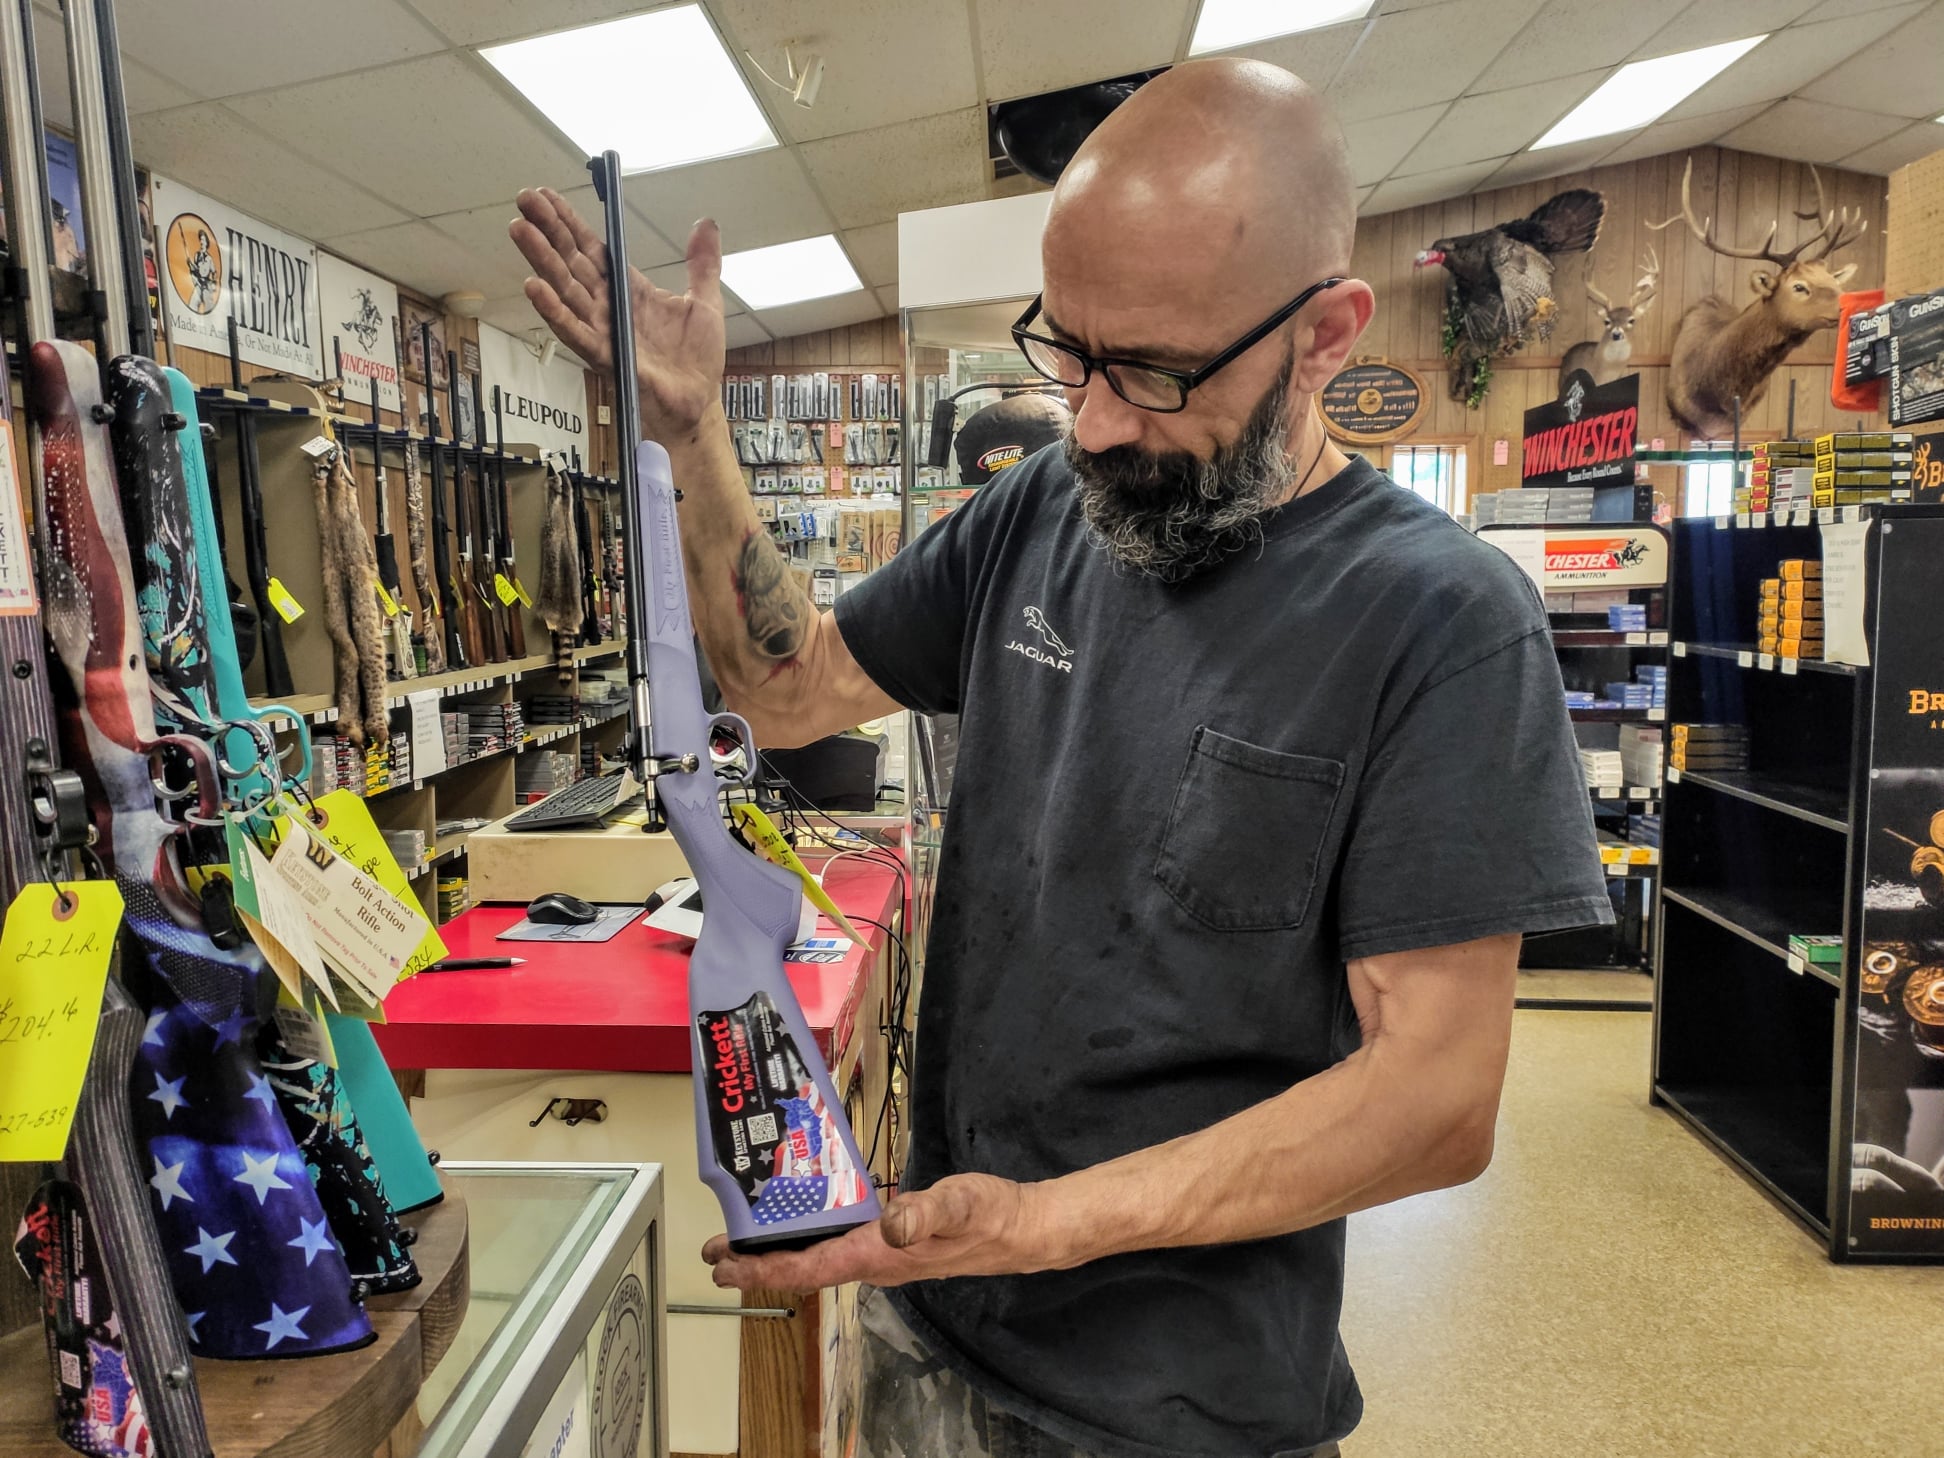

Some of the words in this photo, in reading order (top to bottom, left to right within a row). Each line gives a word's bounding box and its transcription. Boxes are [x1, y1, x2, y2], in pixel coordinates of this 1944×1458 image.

[226, 226, 310, 349] HENRY
[170, 313, 197, 333] Made
[245, 333, 256, 348] Or
[257, 337, 272, 353] Not
[1890, 336, 1899, 363] SKIN
[1891, 365, 1900, 420] SHOTGUN
[504, 391, 582, 434] LEUPOLD
[984, 451, 1004, 465] NITE
[1004, 448, 1024, 459] LITE
[1524, 406, 1637, 479] WINCHESTER
[1593, 465, 1607, 479] Round
[1545, 553, 1610, 569] CHESTER
[1554, 572, 1607, 580] AMMUNITION
[1004, 640, 1072, 674] JAGUAR
[351, 877, 373, 901] Bolt
[372, 900, 406, 932] Action
[356, 906, 381, 933] Rifle
[333, 906, 368, 941] Manufactured
[732, 1023, 746, 1048] Rifle
[710, 1016, 742, 1113] Crickett
[738, 1048, 751, 1072] First
[767, 1059, 778, 1088] LIFETIME
[774, 1054, 787, 1090] WARRANTY!
[742, 1073, 755, 1091] My
[730, 1120, 744, 1155] KEYSTONE
[793, 1130, 808, 1159] USA
[1871, 1218, 1944, 1229] BROWNIN
[74, 1282, 82, 1317] LIFETIME
[95, 1389, 111, 1422] USA
